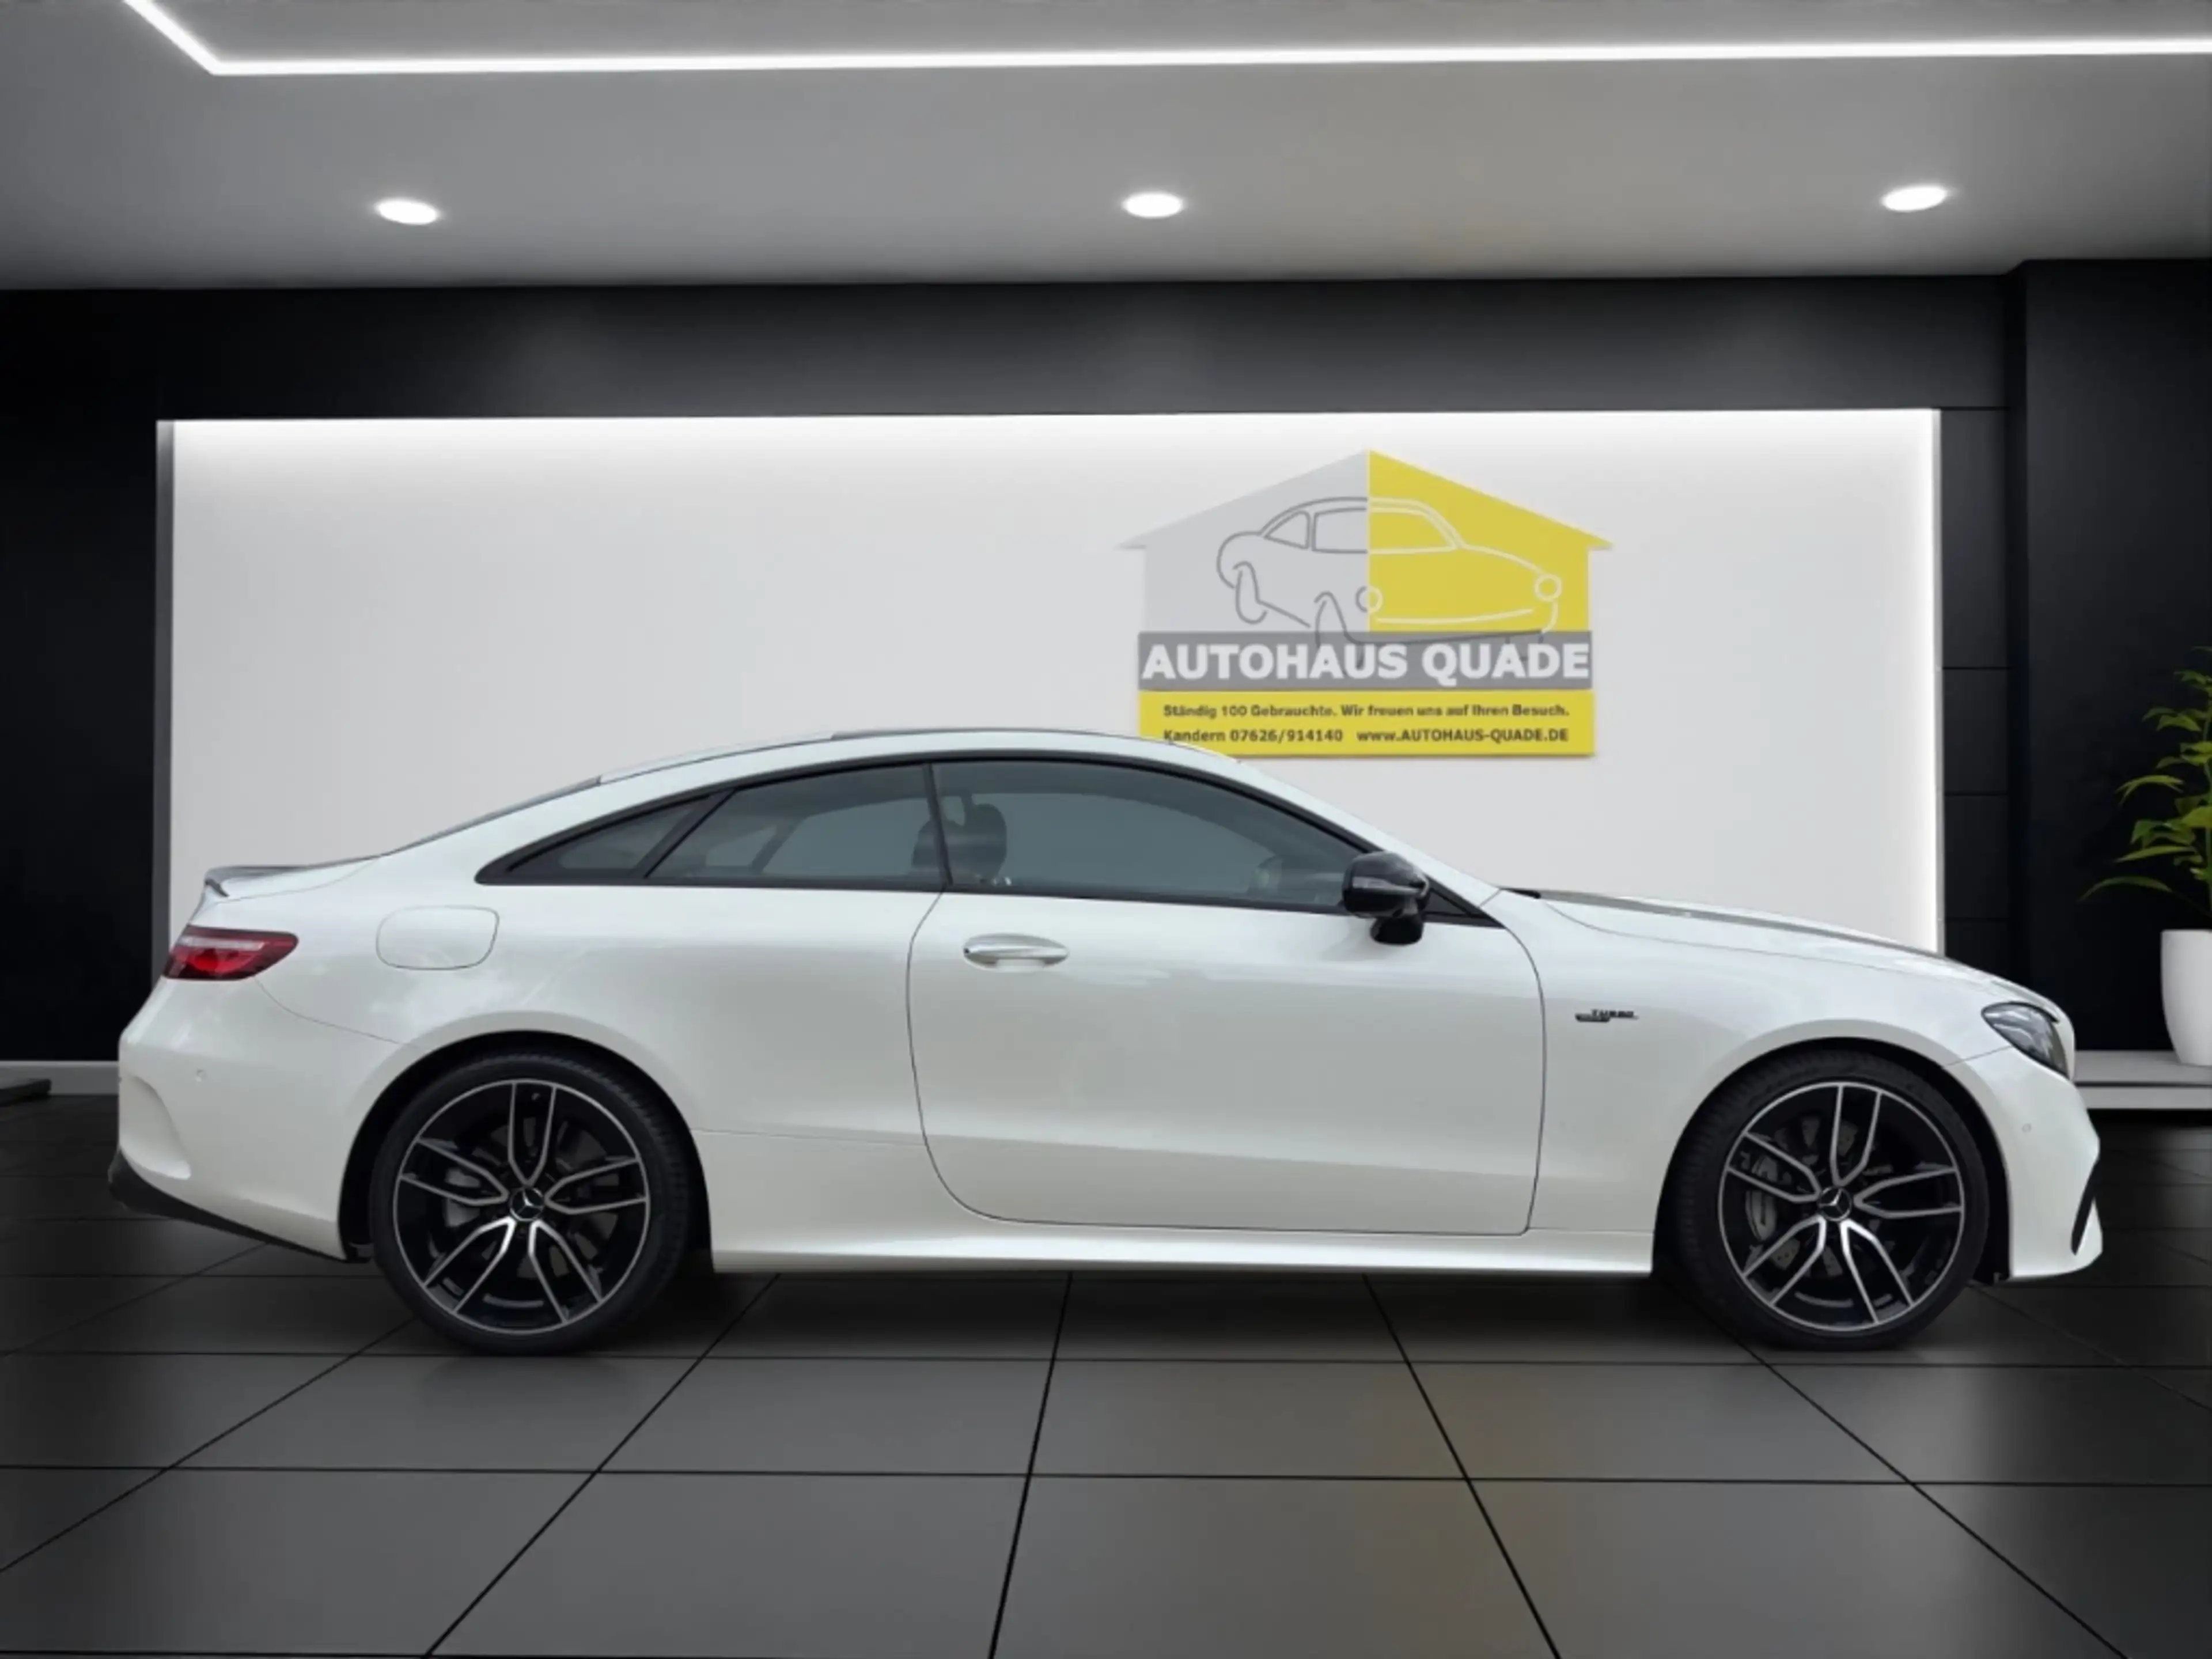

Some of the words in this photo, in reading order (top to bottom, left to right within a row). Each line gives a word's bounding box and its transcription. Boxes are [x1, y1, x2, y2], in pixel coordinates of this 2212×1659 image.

[1142, 644, 1408, 680] AUTOHAUS
[1422, 643, 1589, 686] QUADE
[1164, 704, 1217, 719] Ständig
[1222, 705, 1248, 716] 100
[1251, 704, 1338, 717] Gebrauchte.
[1340, 704, 1364, 717] Wir
[1368, 704, 1414, 716] freuen
[1416, 706, 1442, 716] uns
[1446, 704, 1469, 716] auf
[1472, 704, 1509, 716] Ihren
[1512, 704, 1570, 716] Besuch.
[1164, 729, 1226, 742] Kandern
[1230, 729, 1343, 743] 07626/914140
[1356, 728, 1569, 744] www.AUTOHAUS-QUADE.DE
